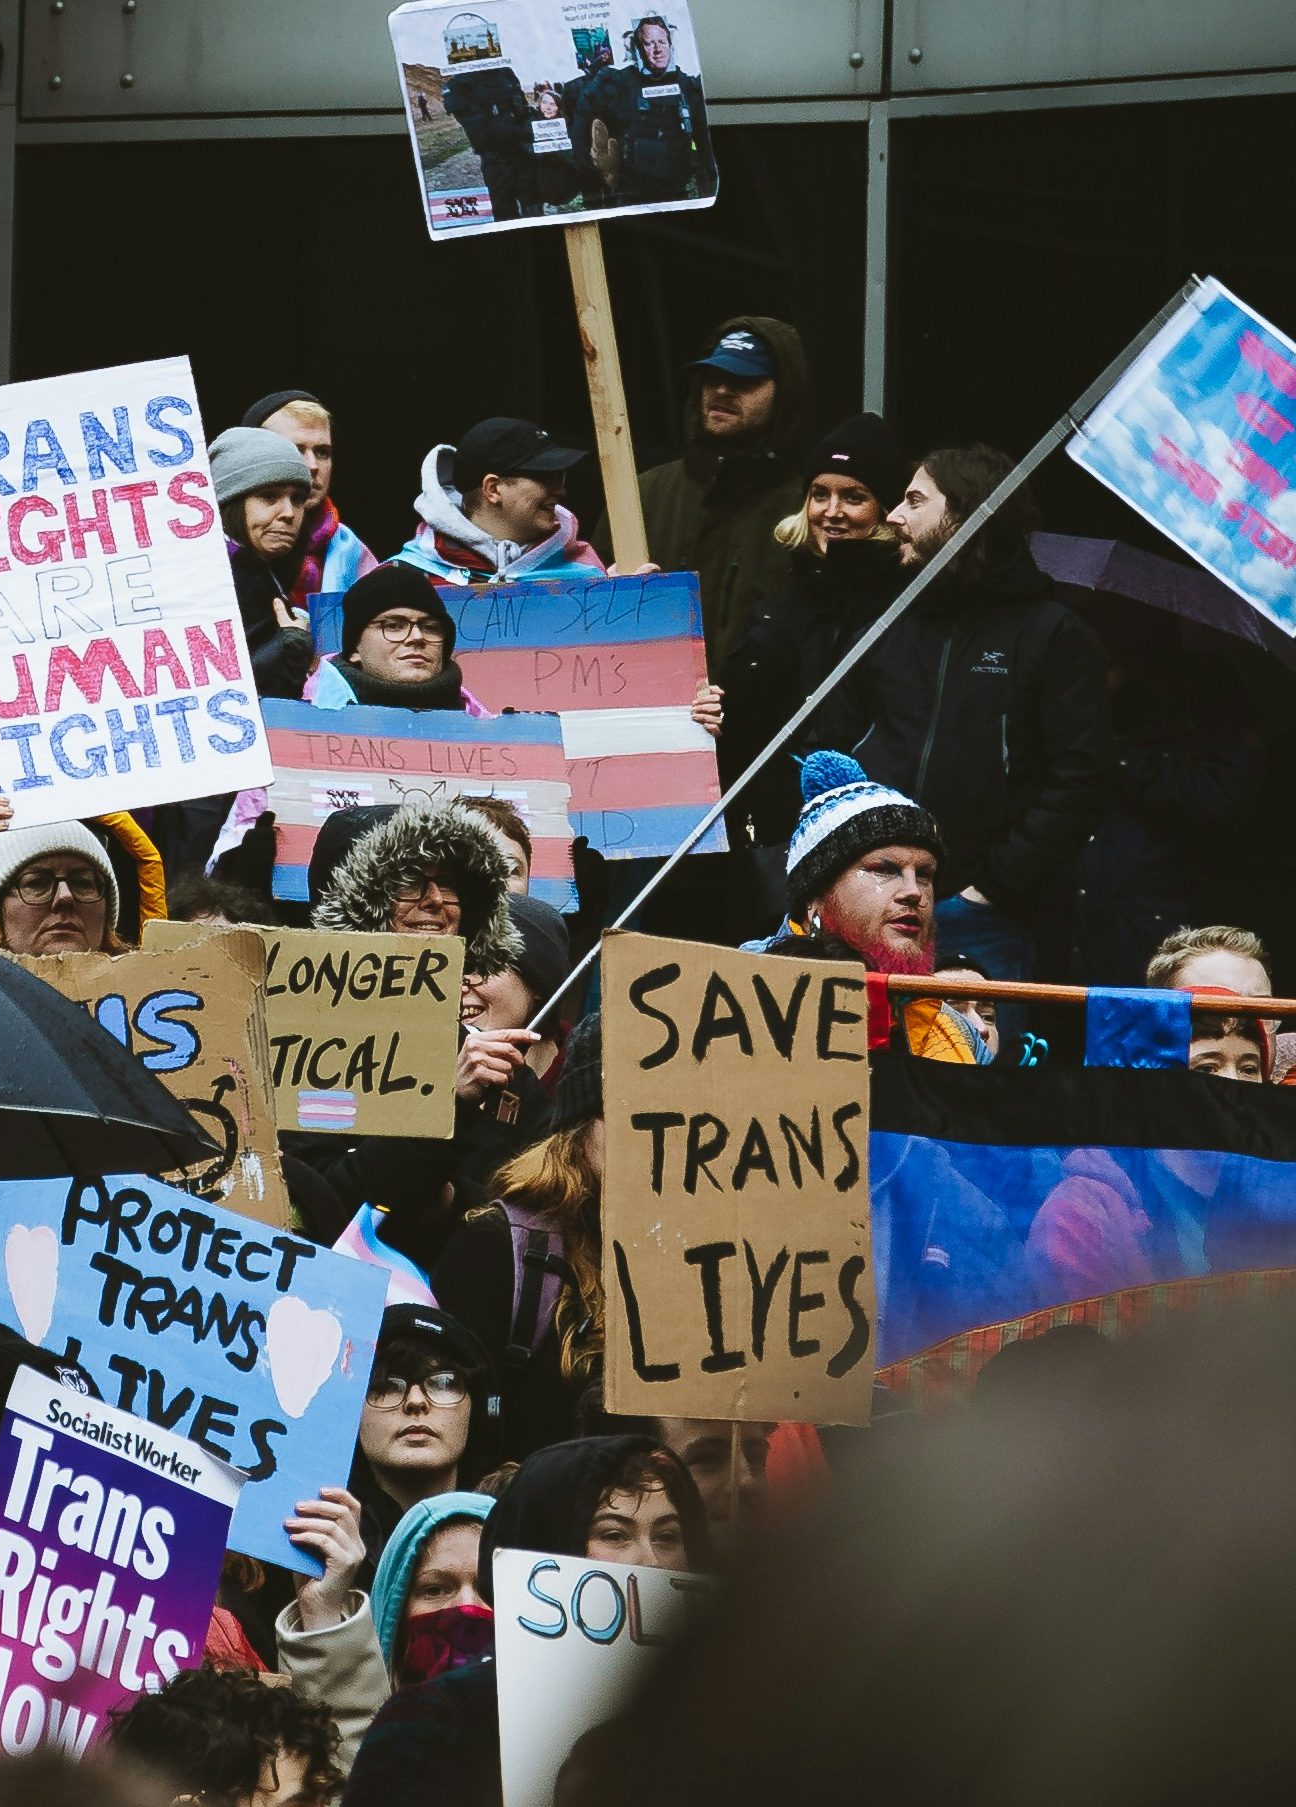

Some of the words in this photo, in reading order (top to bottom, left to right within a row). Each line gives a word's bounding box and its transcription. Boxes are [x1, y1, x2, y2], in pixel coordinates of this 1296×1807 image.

[458, 586, 533, 653] CAN
[555, 578, 677, 635] SELF
[534, 650, 628, 697] PM's
[296, 732, 406, 770] TRANS
[427, 743, 519, 777] LIVES
[265, 941, 449, 1007] LONGER
[629, 962, 866, 1071] SAVE
[630, 1101, 862, 1197] TRANS
[60, 1176, 317, 1293] PROTECT
[89, 1251, 267, 1373] TRANS
[612, 1237, 871, 1383] LIVES
[45, 1398, 135, 1456] Socialist
[134, 1434, 202, 1486] Worker
[4, 1418, 176, 1581] Trans
[517, 1559, 709, 1647] SOL
